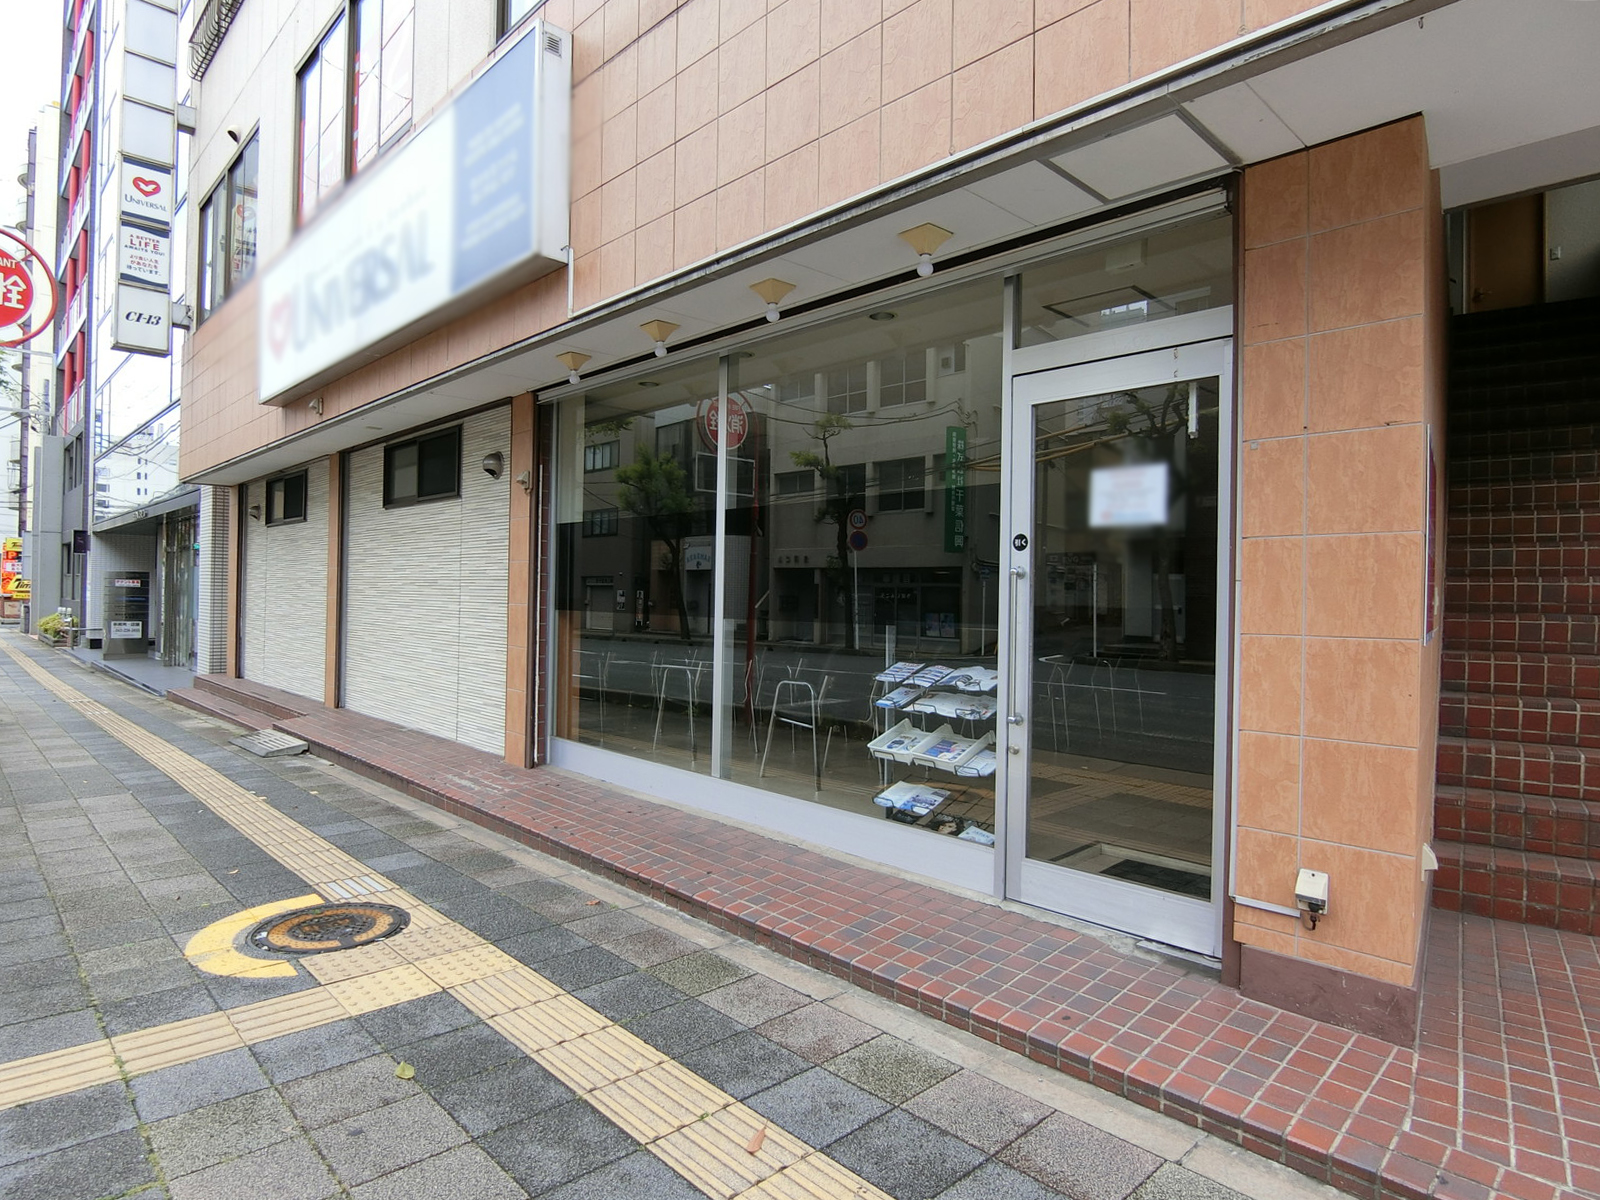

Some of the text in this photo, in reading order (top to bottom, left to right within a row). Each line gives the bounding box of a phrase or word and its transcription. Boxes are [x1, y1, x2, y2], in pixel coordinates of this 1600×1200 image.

[124, 193, 168, 212] UNIVERSAL
[130, 238, 160, 251] LIFE
[136, 235, 160, 243] BETTER
[124, 244, 148, 253] AWAITS
[130, 254, 159, 264] より良い人生
[126, 264, 162, 276] 待っています。
[130, 260, 158, 270] があなたを
[0, 272, 27, 309] 栓
[125, 310, 162, 326] CI-13
[1014, 538, 1027, 547] 引く
